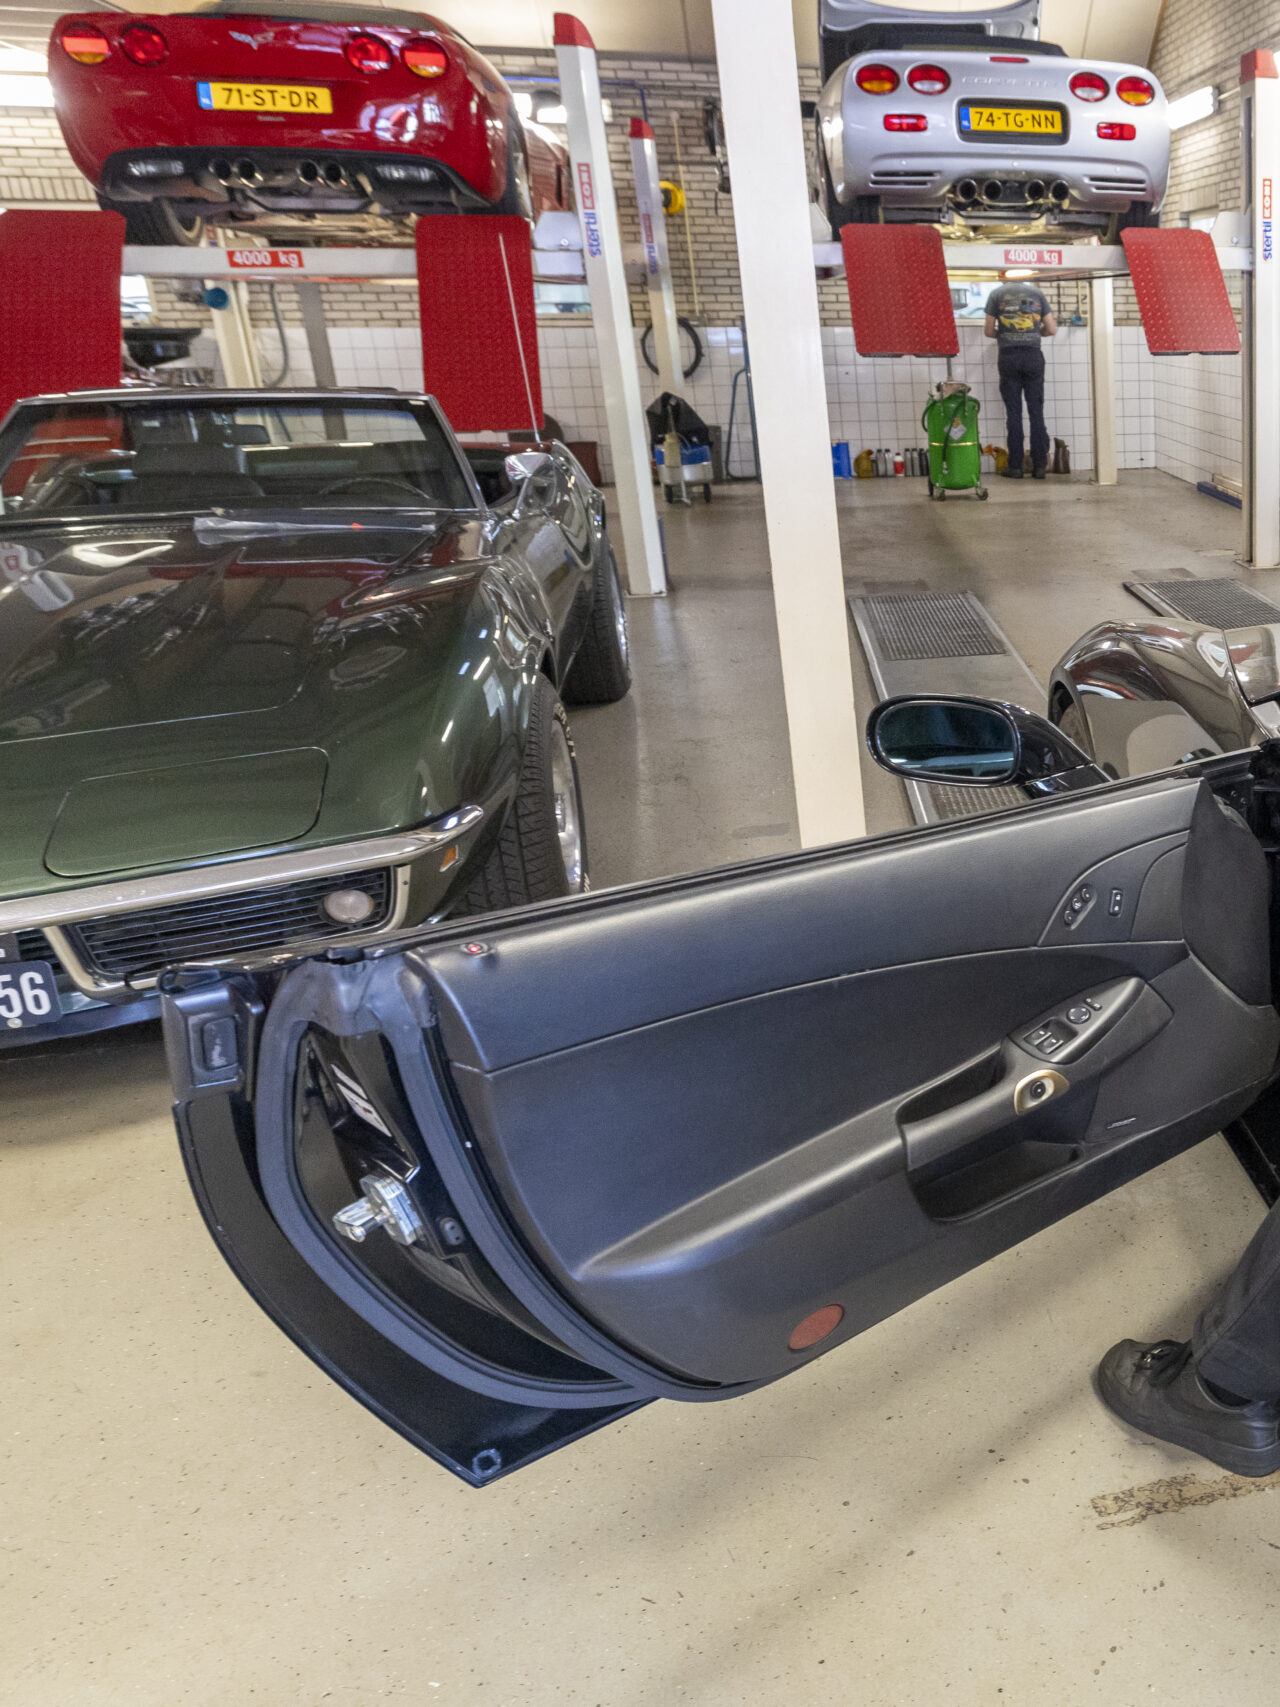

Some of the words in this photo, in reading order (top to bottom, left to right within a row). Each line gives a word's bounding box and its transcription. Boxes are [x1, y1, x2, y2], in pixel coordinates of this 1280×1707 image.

[221, 87, 320, 109] 71-ST-DR
[974, 111, 1056, 129] 74-TG-NN
[1263, 179, 1272, 219] KONI
[583, 212, 602, 257] stertil
[1262, 221, 1273, 261] stertil
[232, 251, 272, 265] 4000
[278, 250, 299, 268] kg
[1008, 249, 1038, 262] 4000
[1044, 249, 1059, 265] kg
[0, 971, 52, 1019] 56
